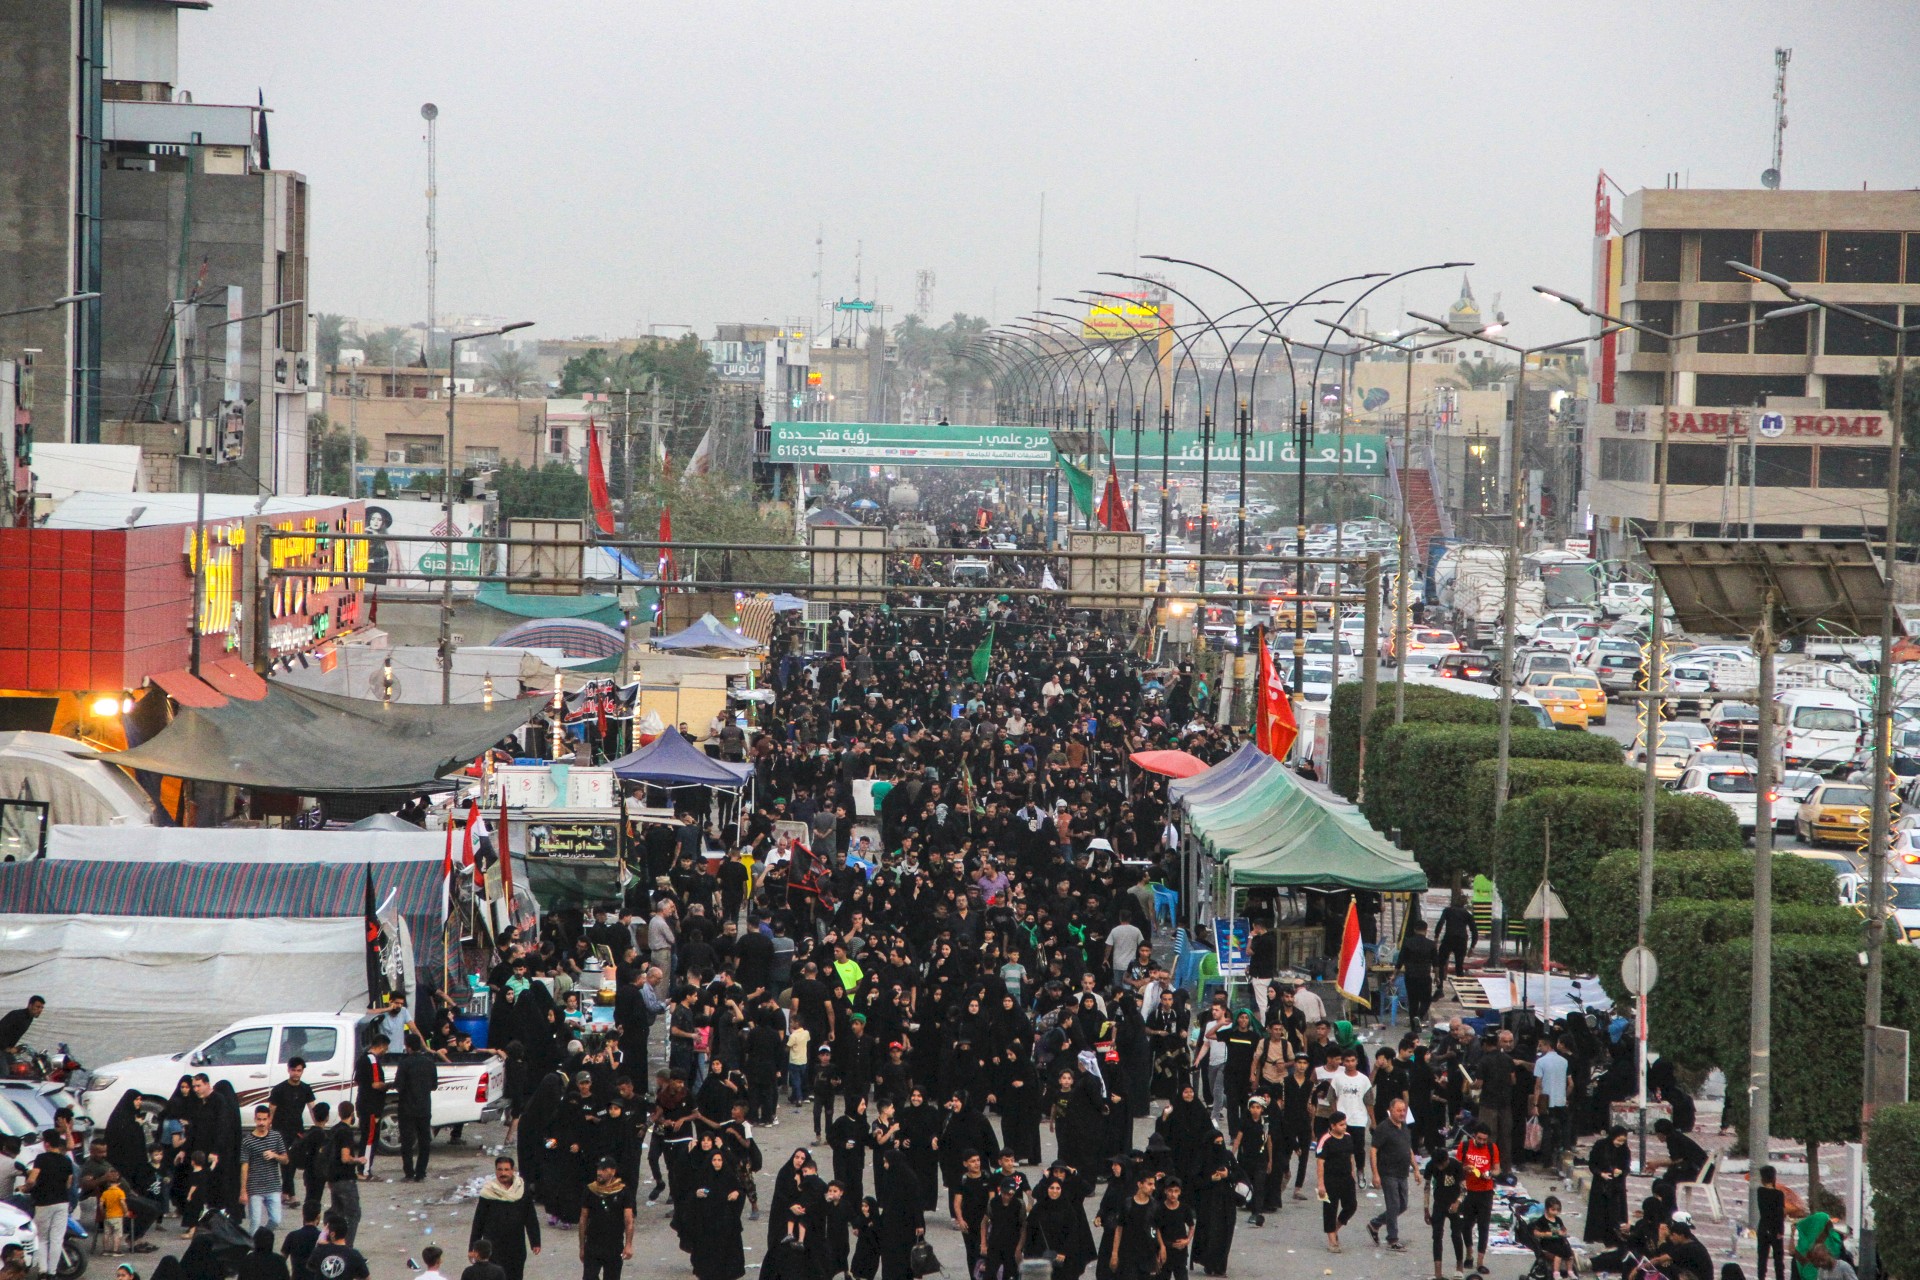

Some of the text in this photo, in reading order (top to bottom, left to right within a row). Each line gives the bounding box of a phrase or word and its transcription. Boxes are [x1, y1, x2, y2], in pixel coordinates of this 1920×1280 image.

[723, 363, 760, 376] هاوس
[1794, 415, 1883, 436] HOME
[778, 428, 840, 443] متجددة
[986, 433, 1022, 446] علمي
[1024, 435, 1049, 448] صرح
[777, 445, 808, 456] 6163
[1280, 441, 1377, 469] جامعة
[551, 825, 592, 838] موكب
[575, 840, 605, 852] خدام
